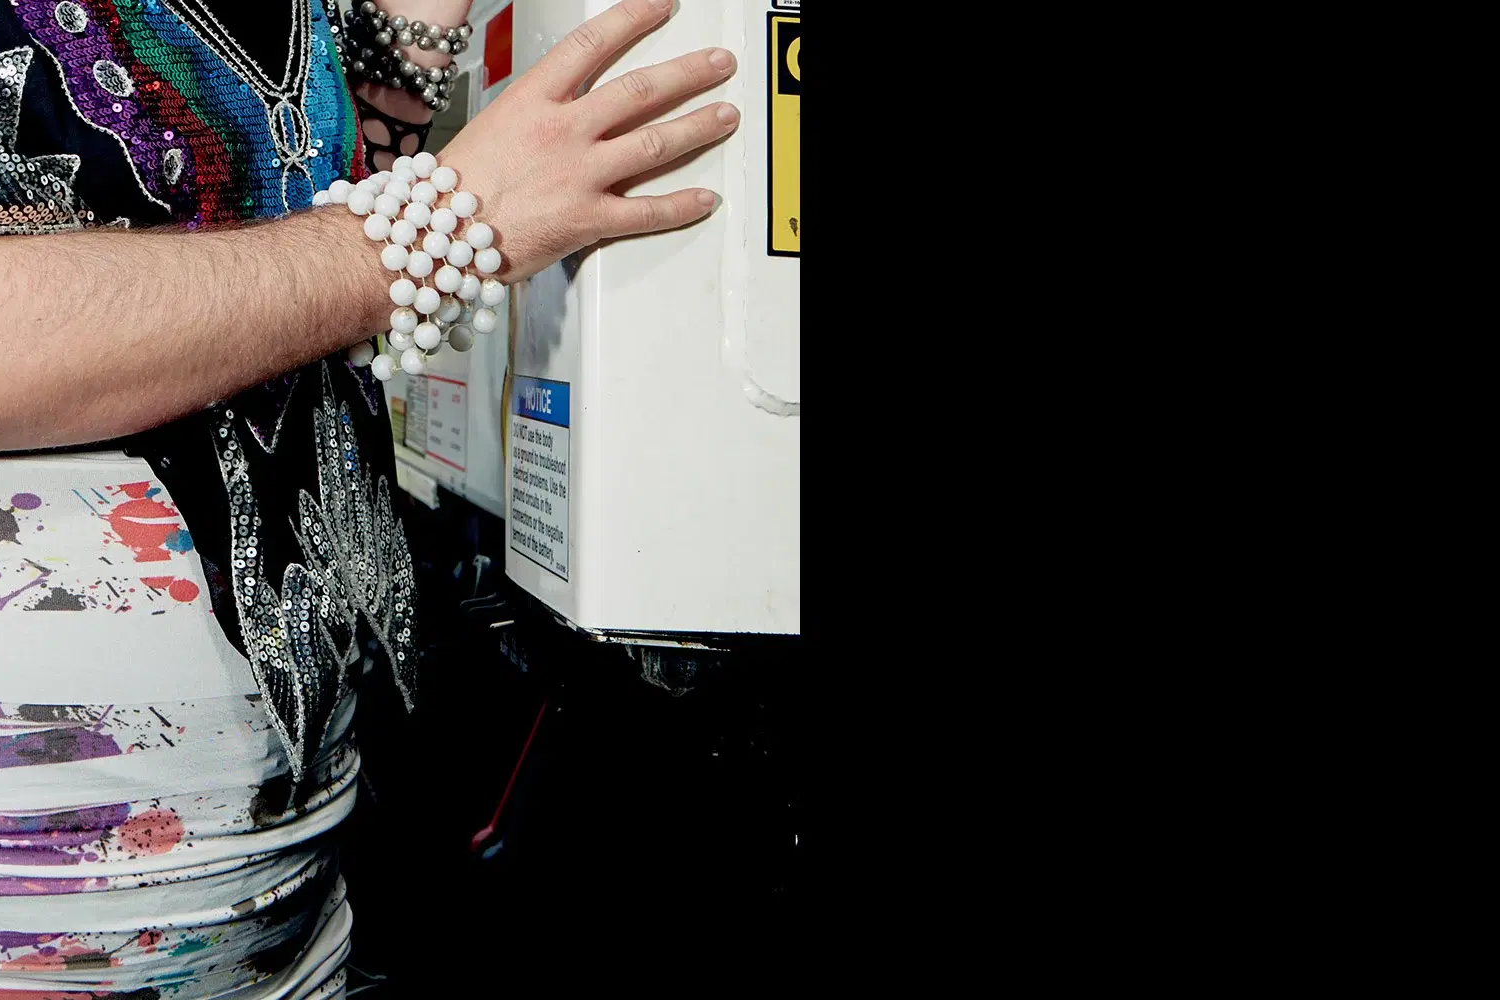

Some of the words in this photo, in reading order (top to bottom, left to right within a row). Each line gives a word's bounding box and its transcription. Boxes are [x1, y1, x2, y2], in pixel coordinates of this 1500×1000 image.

[525, 386, 552, 414] NOTICE
[542, 430, 553, 452] body
[539, 452, 566, 476] troubleshoot
[550, 476, 558, 496] Use
